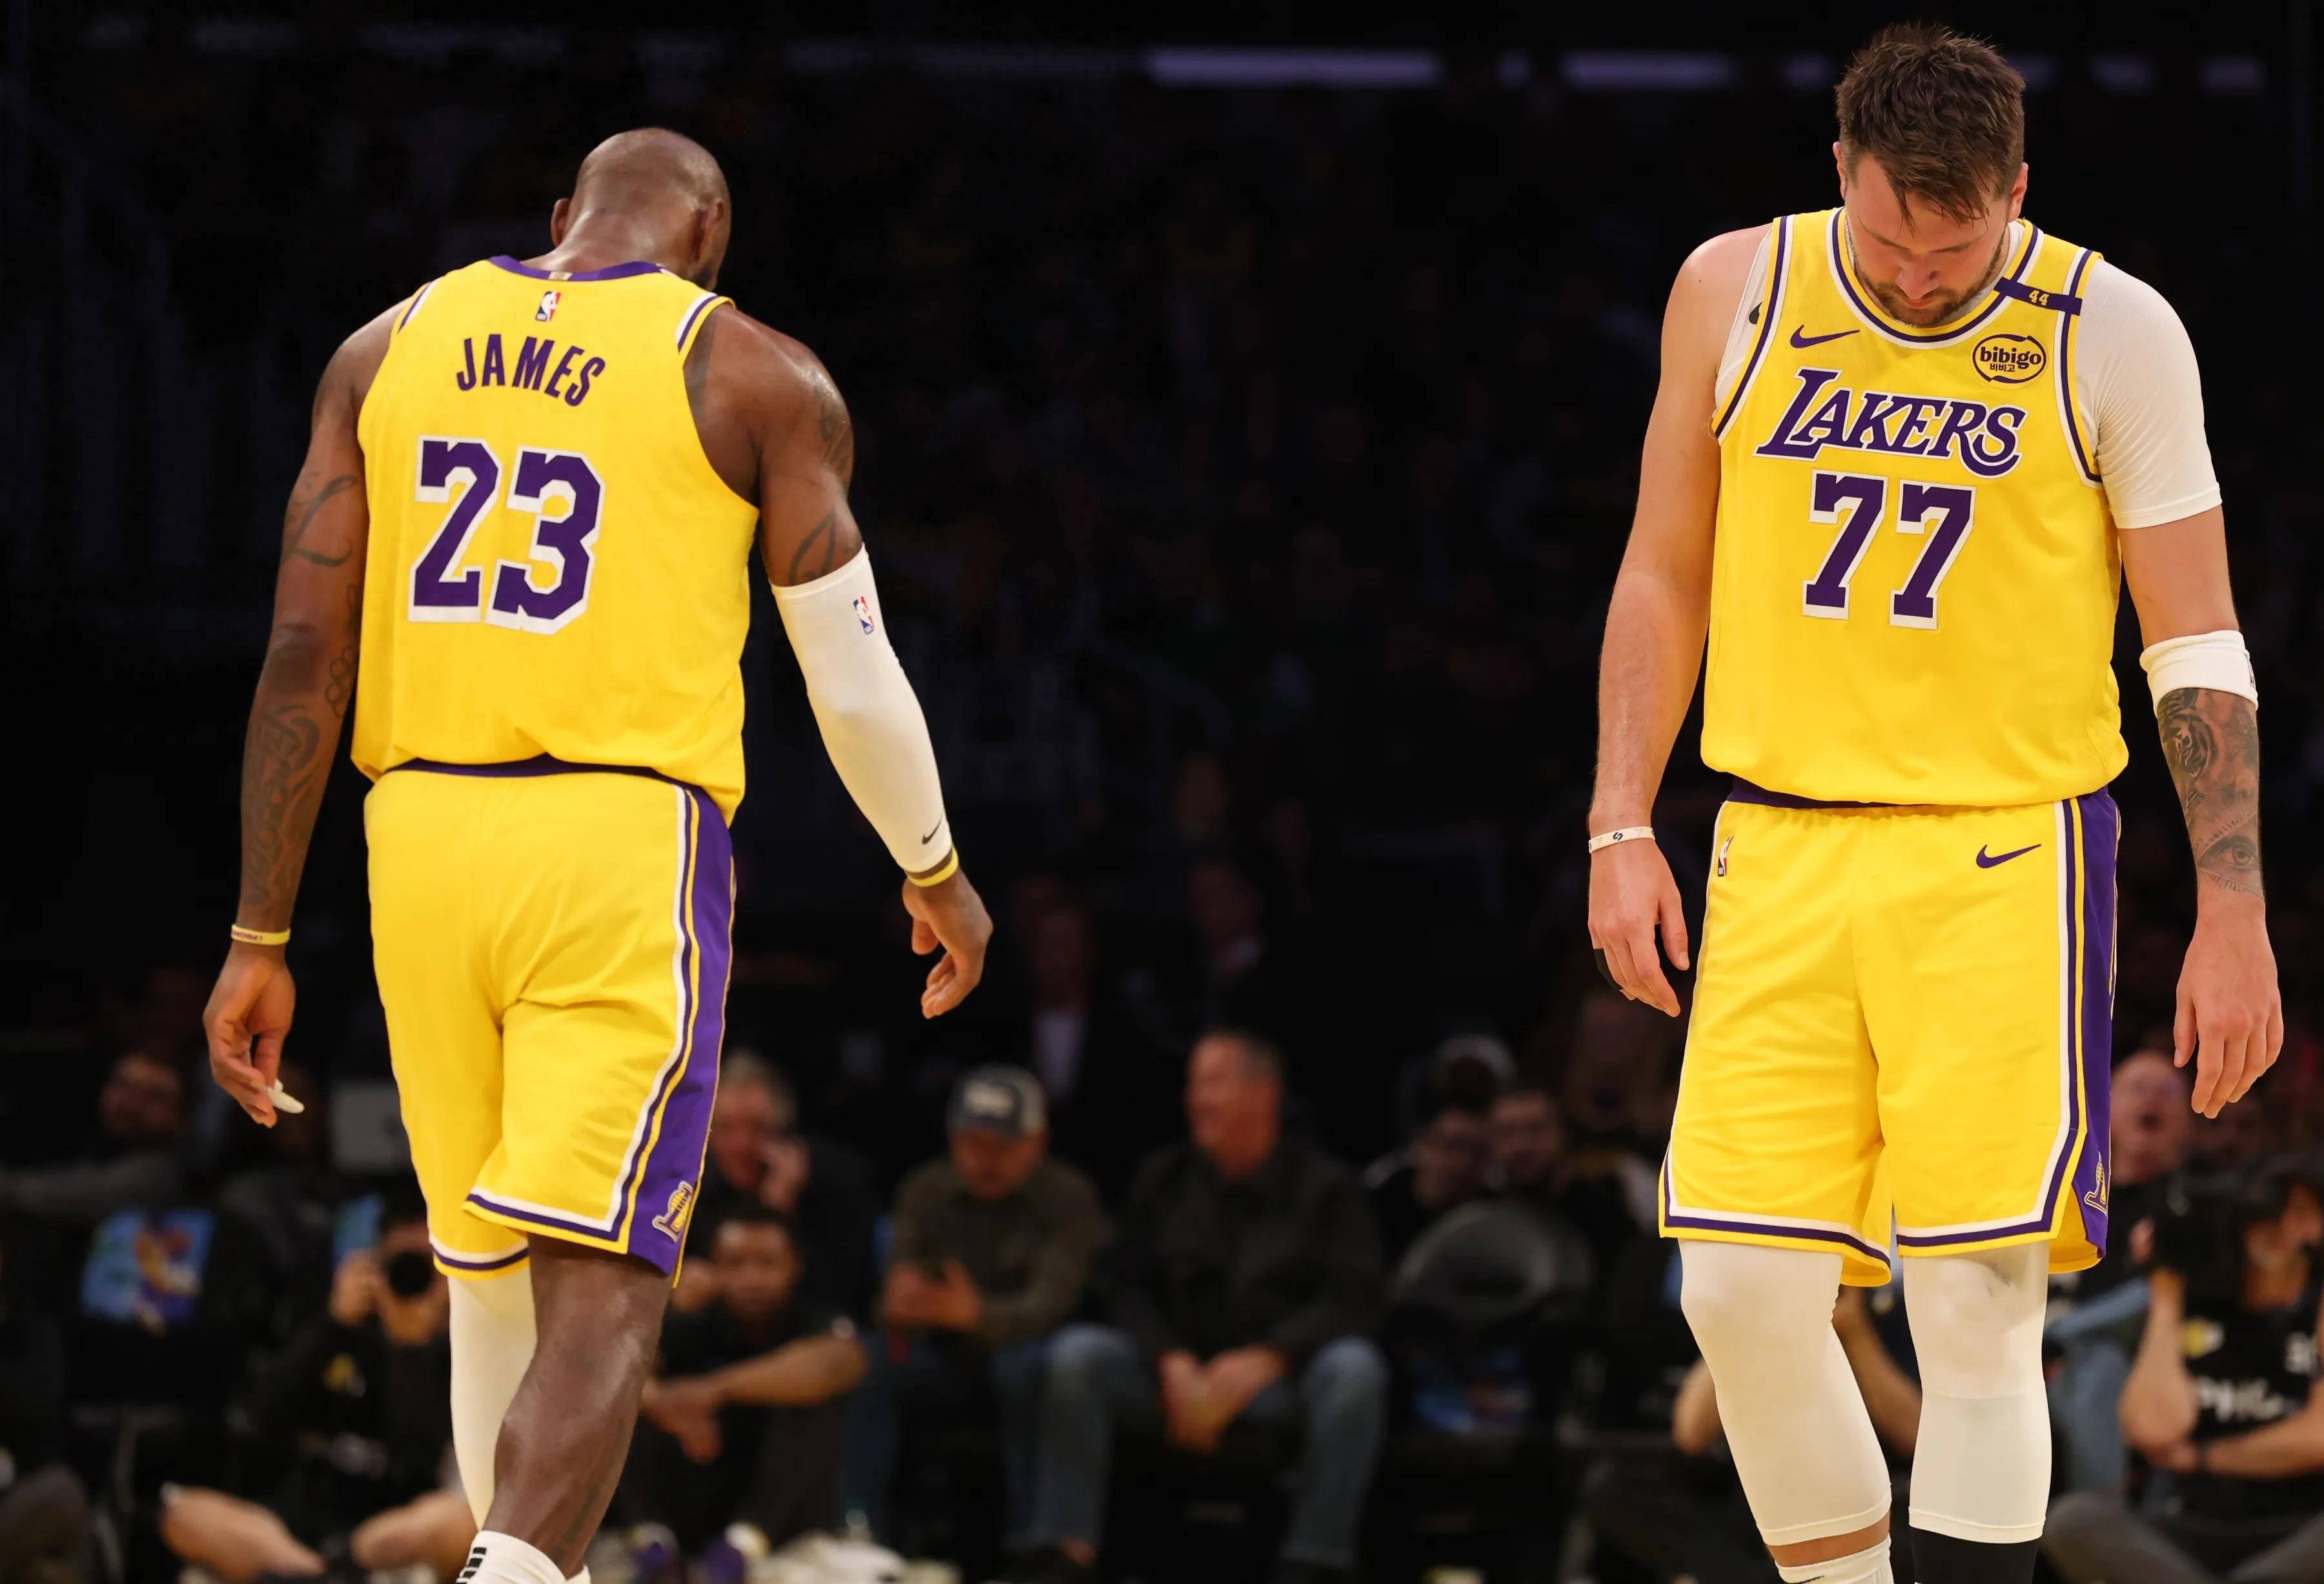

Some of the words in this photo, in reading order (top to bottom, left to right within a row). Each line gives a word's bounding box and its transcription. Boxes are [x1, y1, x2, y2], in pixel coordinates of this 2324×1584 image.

[2028, 290, 2050, 306] 44
[456, 333, 606, 407] JAMES
[1980, 346, 2042, 369] bibigo
[1990, 363, 2015, 372] 비비고
[1753, 367, 2028, 479] LAKERS
[408, 435, 605, 635] 23
[1802, 469, 1976, 630] 77
